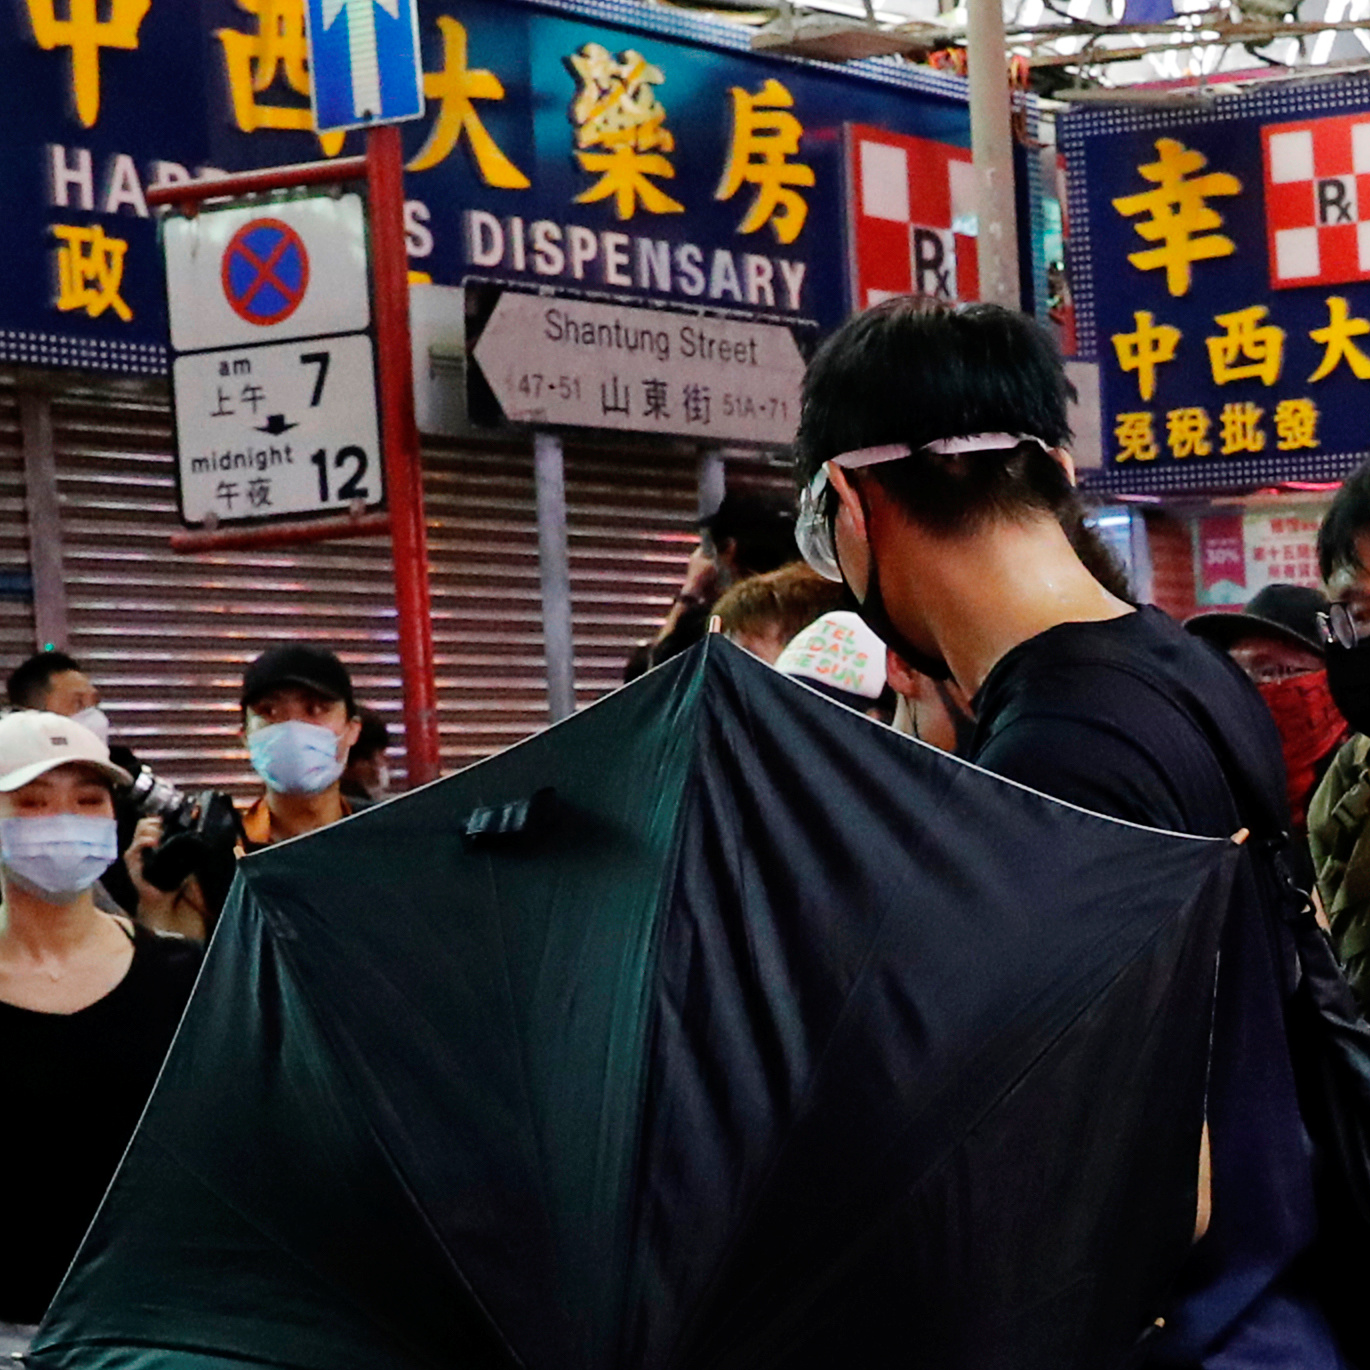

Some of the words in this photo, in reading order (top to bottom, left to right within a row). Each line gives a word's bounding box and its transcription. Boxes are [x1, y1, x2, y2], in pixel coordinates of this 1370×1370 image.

[469, 208, 806, 311] DISPENSARY
[545, 308, 671, 362] Shantung
[680, 325, 758, 366] Street
[210, 384, 266, 418] 上午
[218, 357, 251, 377] am
[301, 352, 330, 408] 7
[601, 376, 711, 425] 山東街
[1114, 398, 1321, 462] 免稅批發
[191, 443, 294, 474] midnight
[311, 444, 370, 503] 12
[216, 476, 275, 510] 午夜
